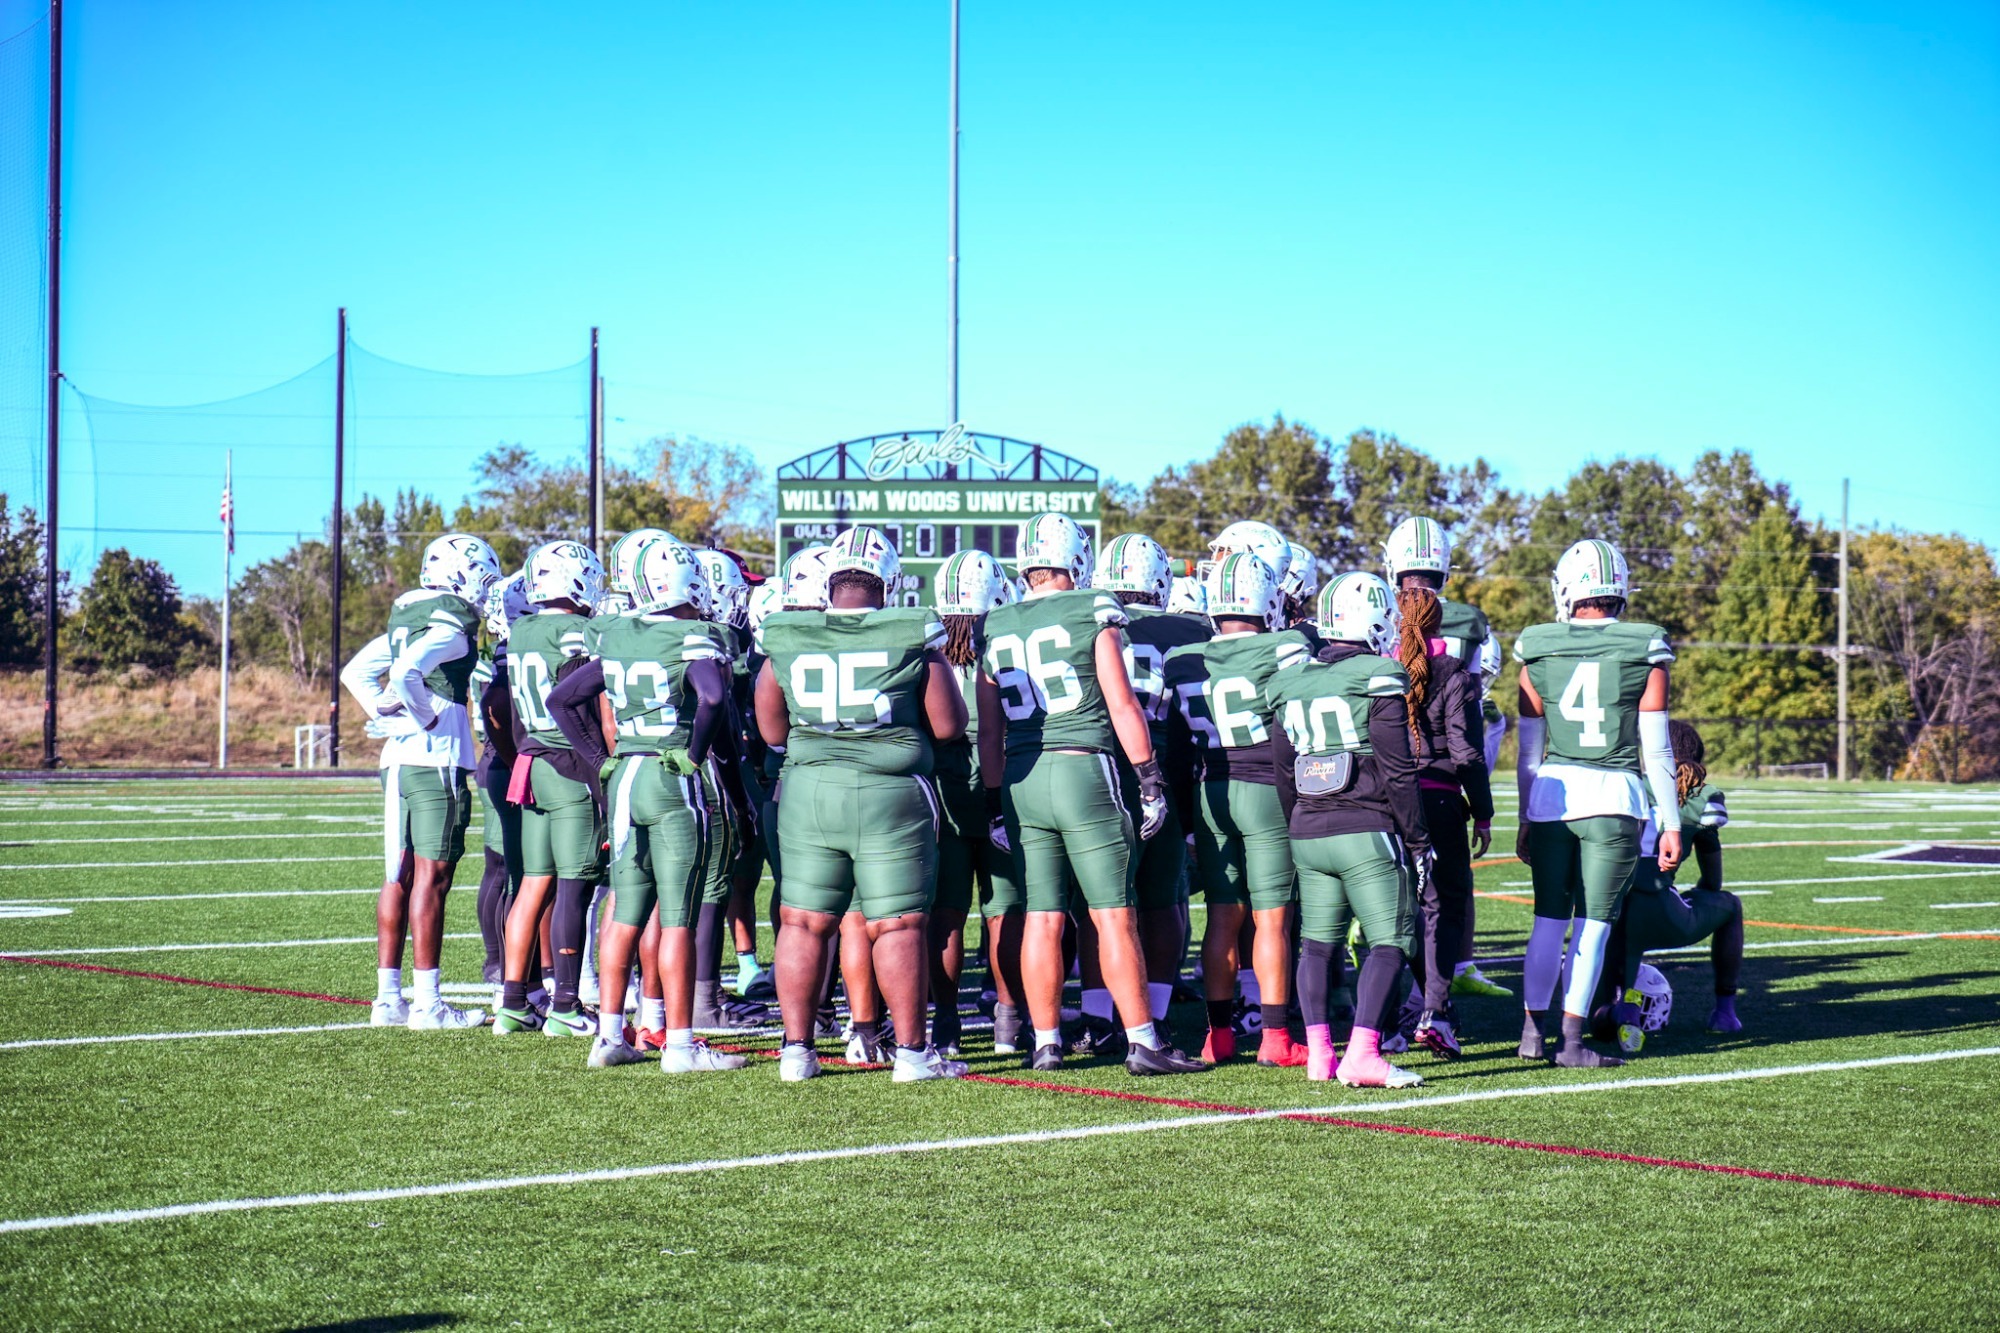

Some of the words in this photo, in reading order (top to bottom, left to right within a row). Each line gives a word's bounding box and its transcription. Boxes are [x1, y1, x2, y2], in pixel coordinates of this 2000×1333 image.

[867, 421, 1009, 480] Owls
[782, 490, 878, 511] WILLIAM
[885, 490, 960, 511] WOODS
[966, 490, 1097, 513] UNIVERSITY
[794, 524, 838, 539] OWLS
[464, 544, 479, 558] 2
[568, 544, 589, 560] 30
[670, 547, 695, 565] 23
[712, 563, 722, 582] 8
[762, 589, 775, 604] 7
[1367, 587, 1388, 608] 40
[987, 625, 1084, 720] 96
[791, 652, 893, 732] 95
[1176, 677, 1269, 749] 56
[1558, 662, 1607, 747] 4
